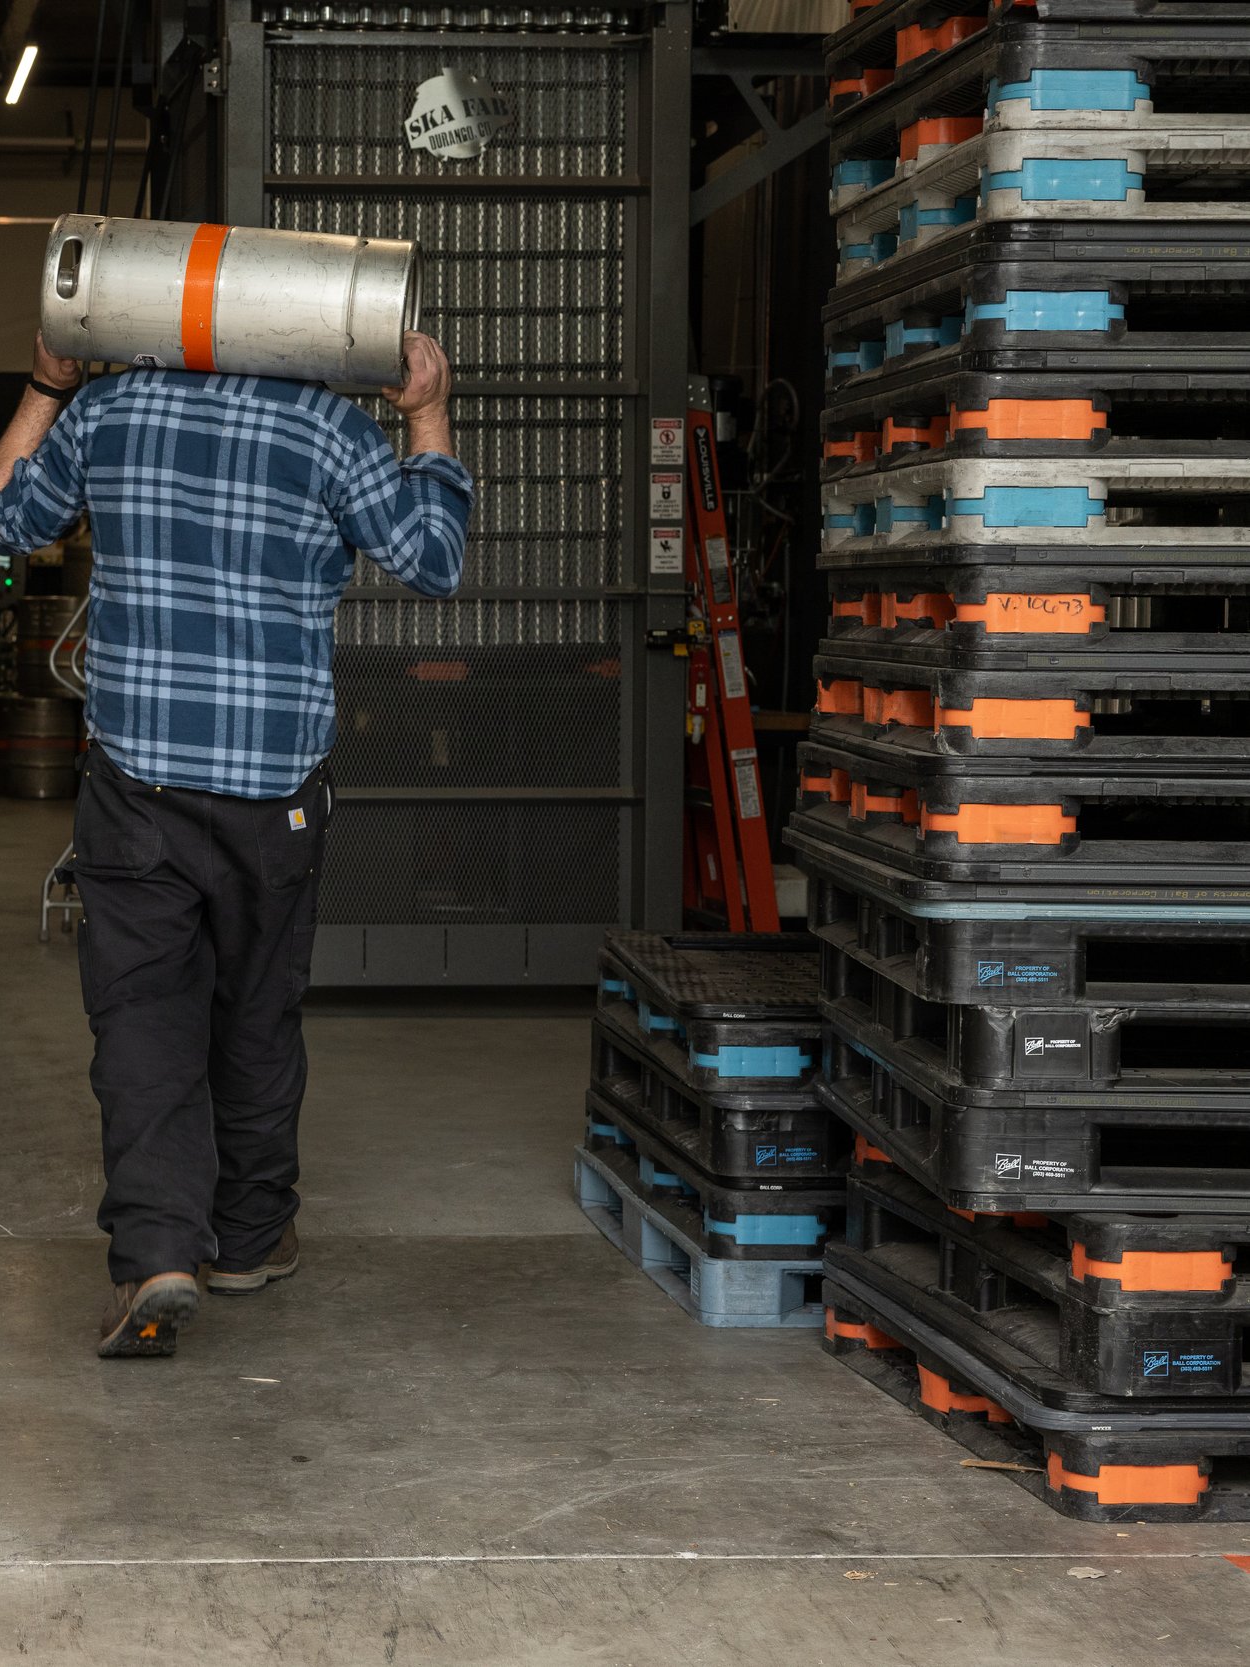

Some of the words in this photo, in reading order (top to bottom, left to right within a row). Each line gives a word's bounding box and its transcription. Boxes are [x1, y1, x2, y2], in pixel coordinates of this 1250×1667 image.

[409, 104, 455, 141] SKA
[462, 97, 509, 118] FAB
[477, 121, 492, 138] CO
[698, 438, 715, 510] LOUISVILLE
